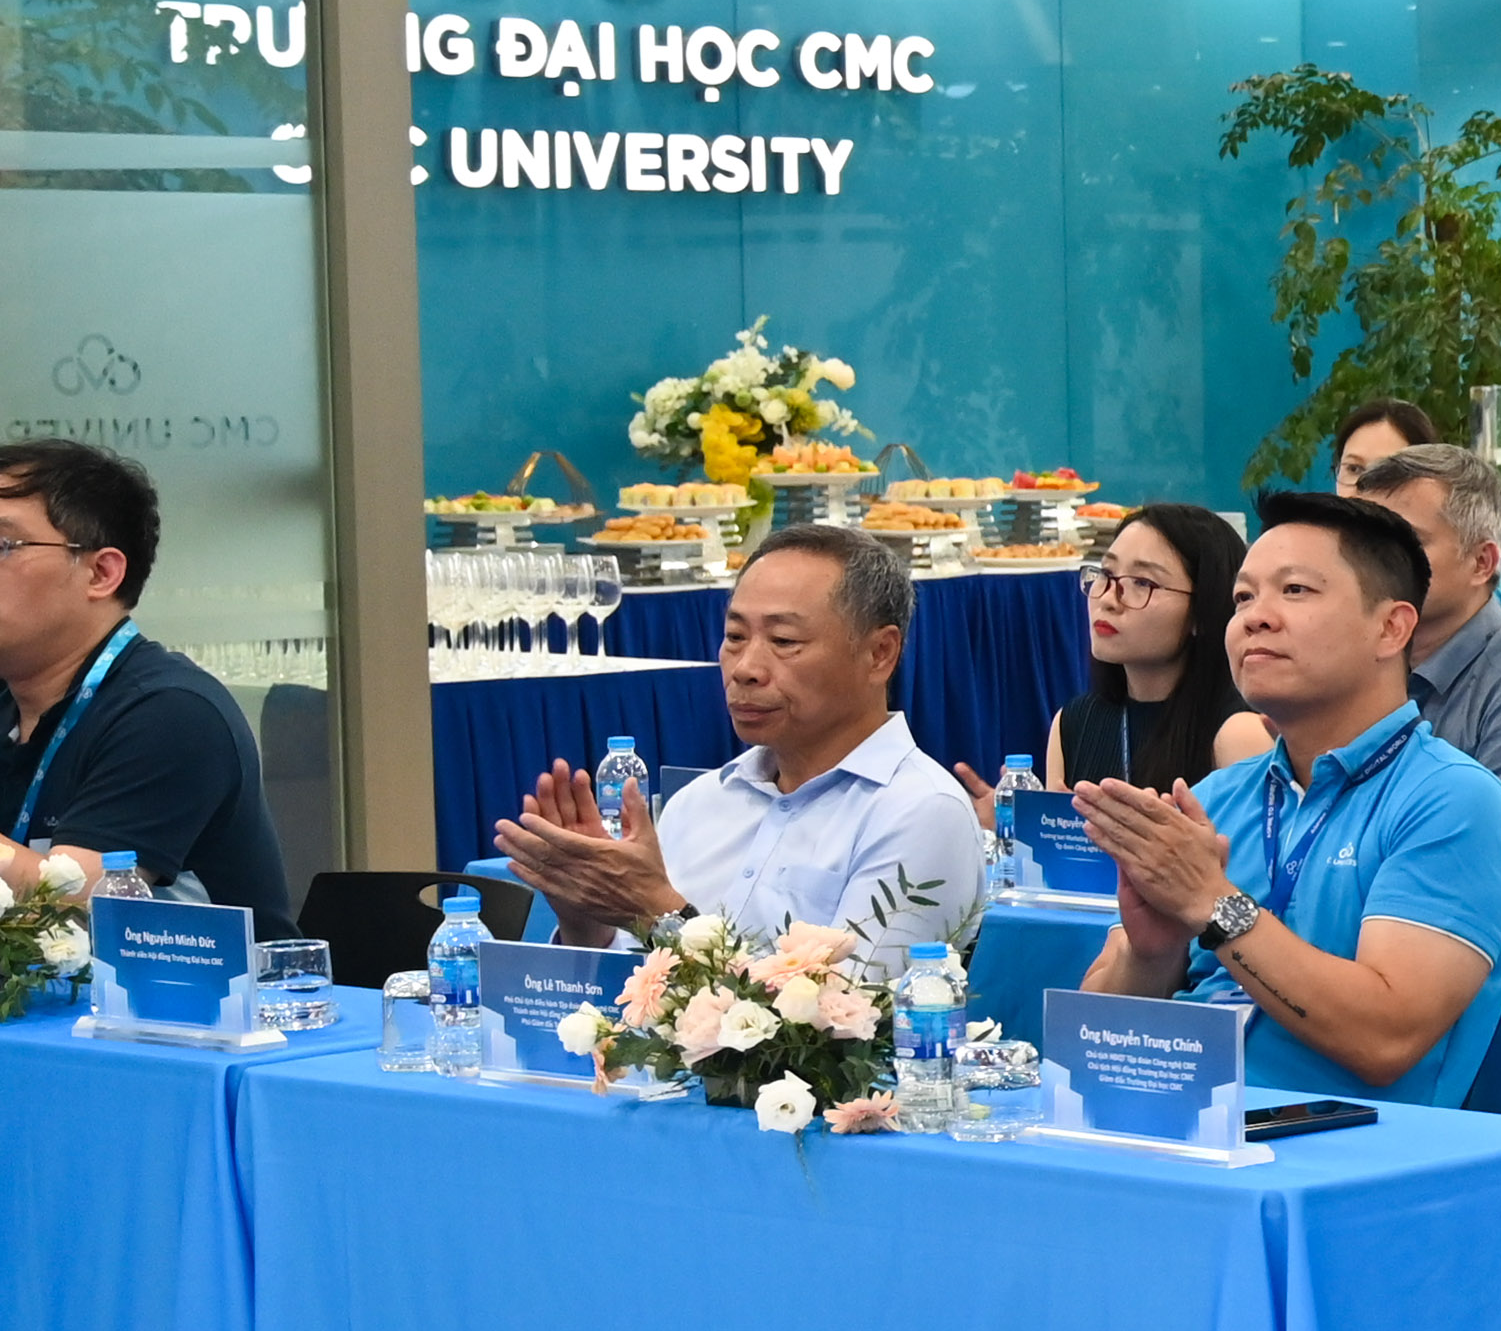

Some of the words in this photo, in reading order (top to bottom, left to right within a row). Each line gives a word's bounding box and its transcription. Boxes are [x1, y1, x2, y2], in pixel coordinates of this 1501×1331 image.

[496, 16, 614, 96] ĐẠI
[638, 24, 779, 102] HỌC
[800, 34, 935, 93] CMC
[450, 126, 854, 195] UNIVERSITY
[524, 974, 542, 992] Ông
[543, 978, 553, 991] Lê
[555, 980, 583, 995] Thanh
[1080, 1024, 1101, 1044] Ông
[1102, 1029, 1141, 1047] Nguyễn
[1142, 1034, 1172, 1052] Trung
[1172, 1038, 1203, 1054] Chính
